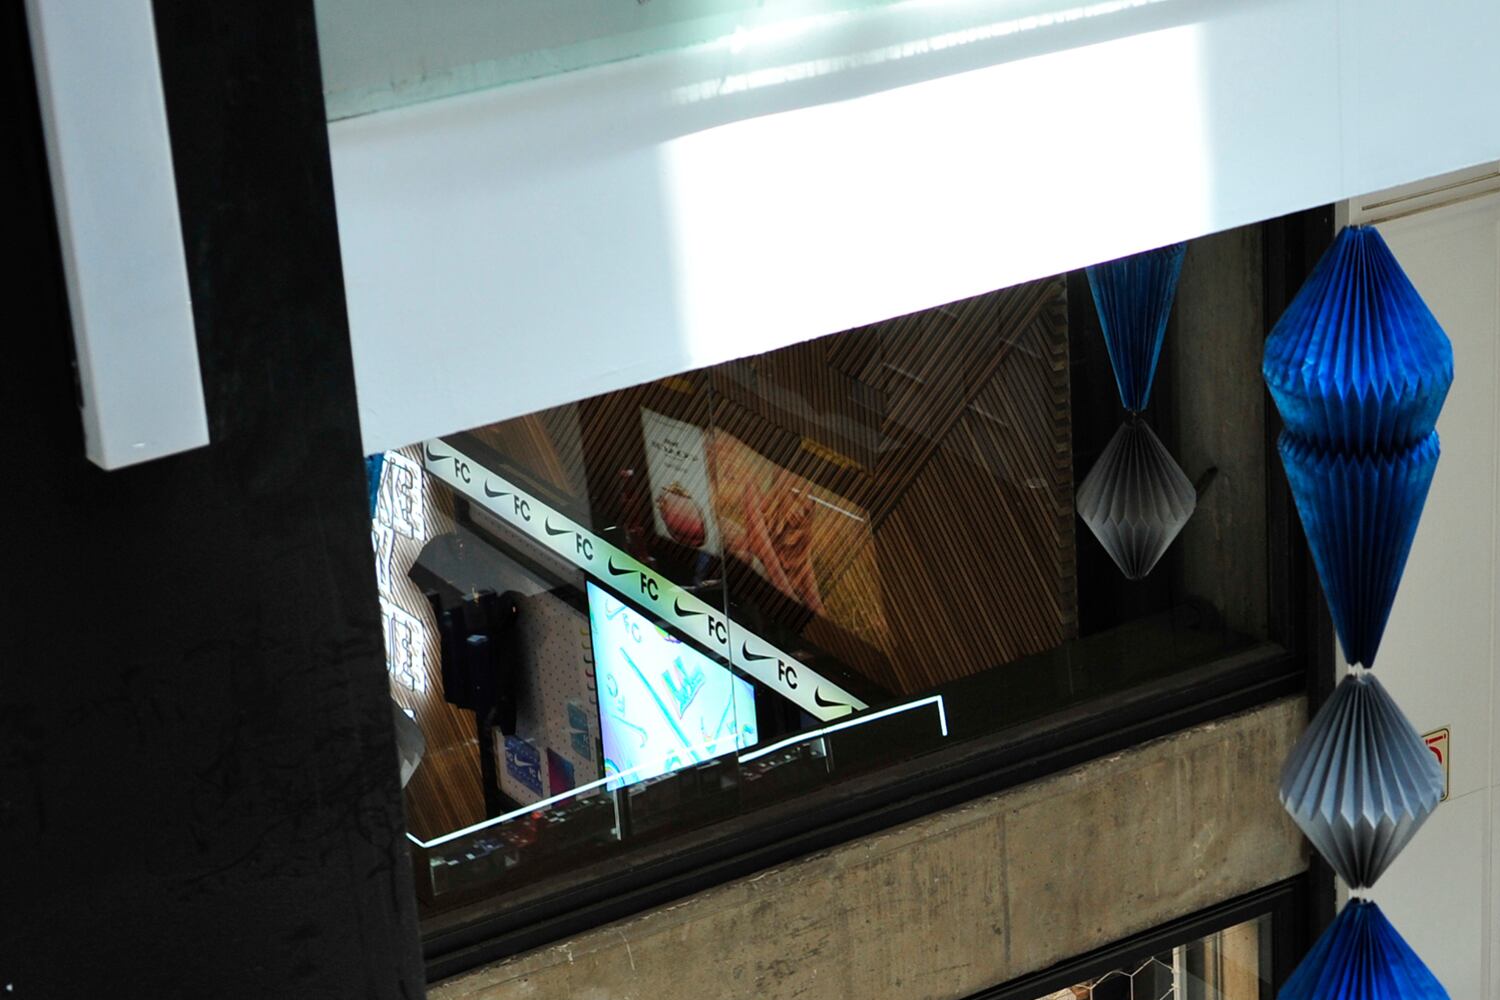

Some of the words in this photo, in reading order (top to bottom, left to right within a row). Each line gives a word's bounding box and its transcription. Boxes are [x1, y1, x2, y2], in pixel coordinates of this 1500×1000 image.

[454, 458, 471, 484] FC
[513, 494, 531, 522] FC
[576, 533, 594, 563] FC
[640, 572, 659, 601] FC
[708, 615, 727, 644] FC
[778, 659, 798, 691] FC
